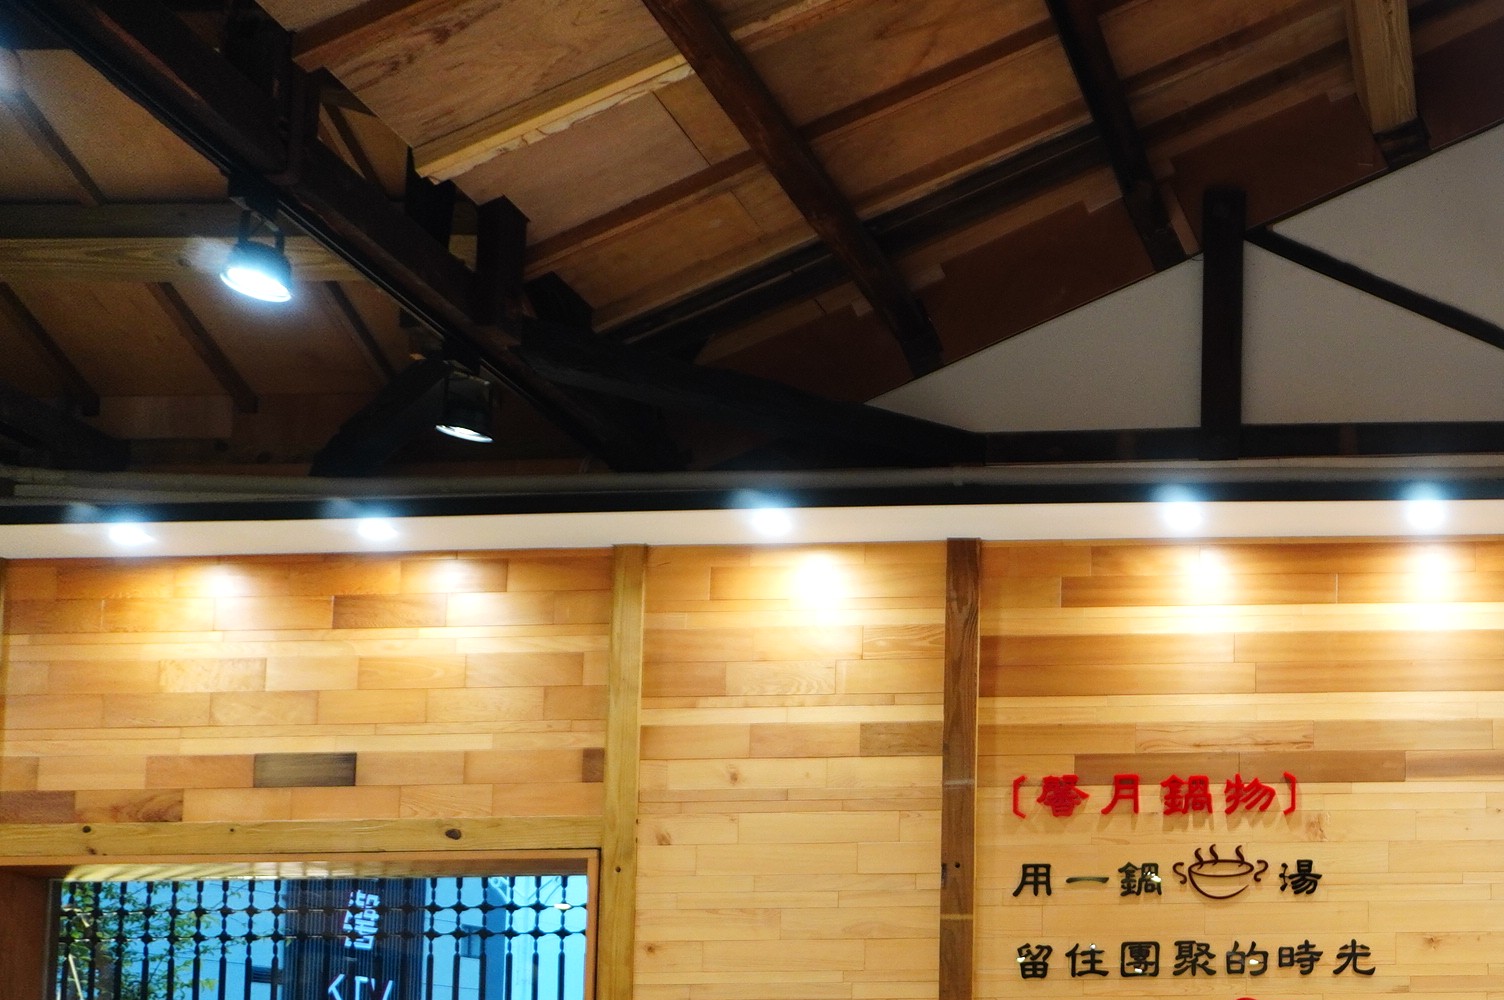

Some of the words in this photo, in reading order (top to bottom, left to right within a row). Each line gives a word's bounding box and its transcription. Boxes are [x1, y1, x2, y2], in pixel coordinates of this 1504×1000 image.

[1013, 861, 1163, 898] 用一鍋
[1279, 859, 1323, 896] 湯
[1016, 939, 1376, 979] 留住團聚的時光
